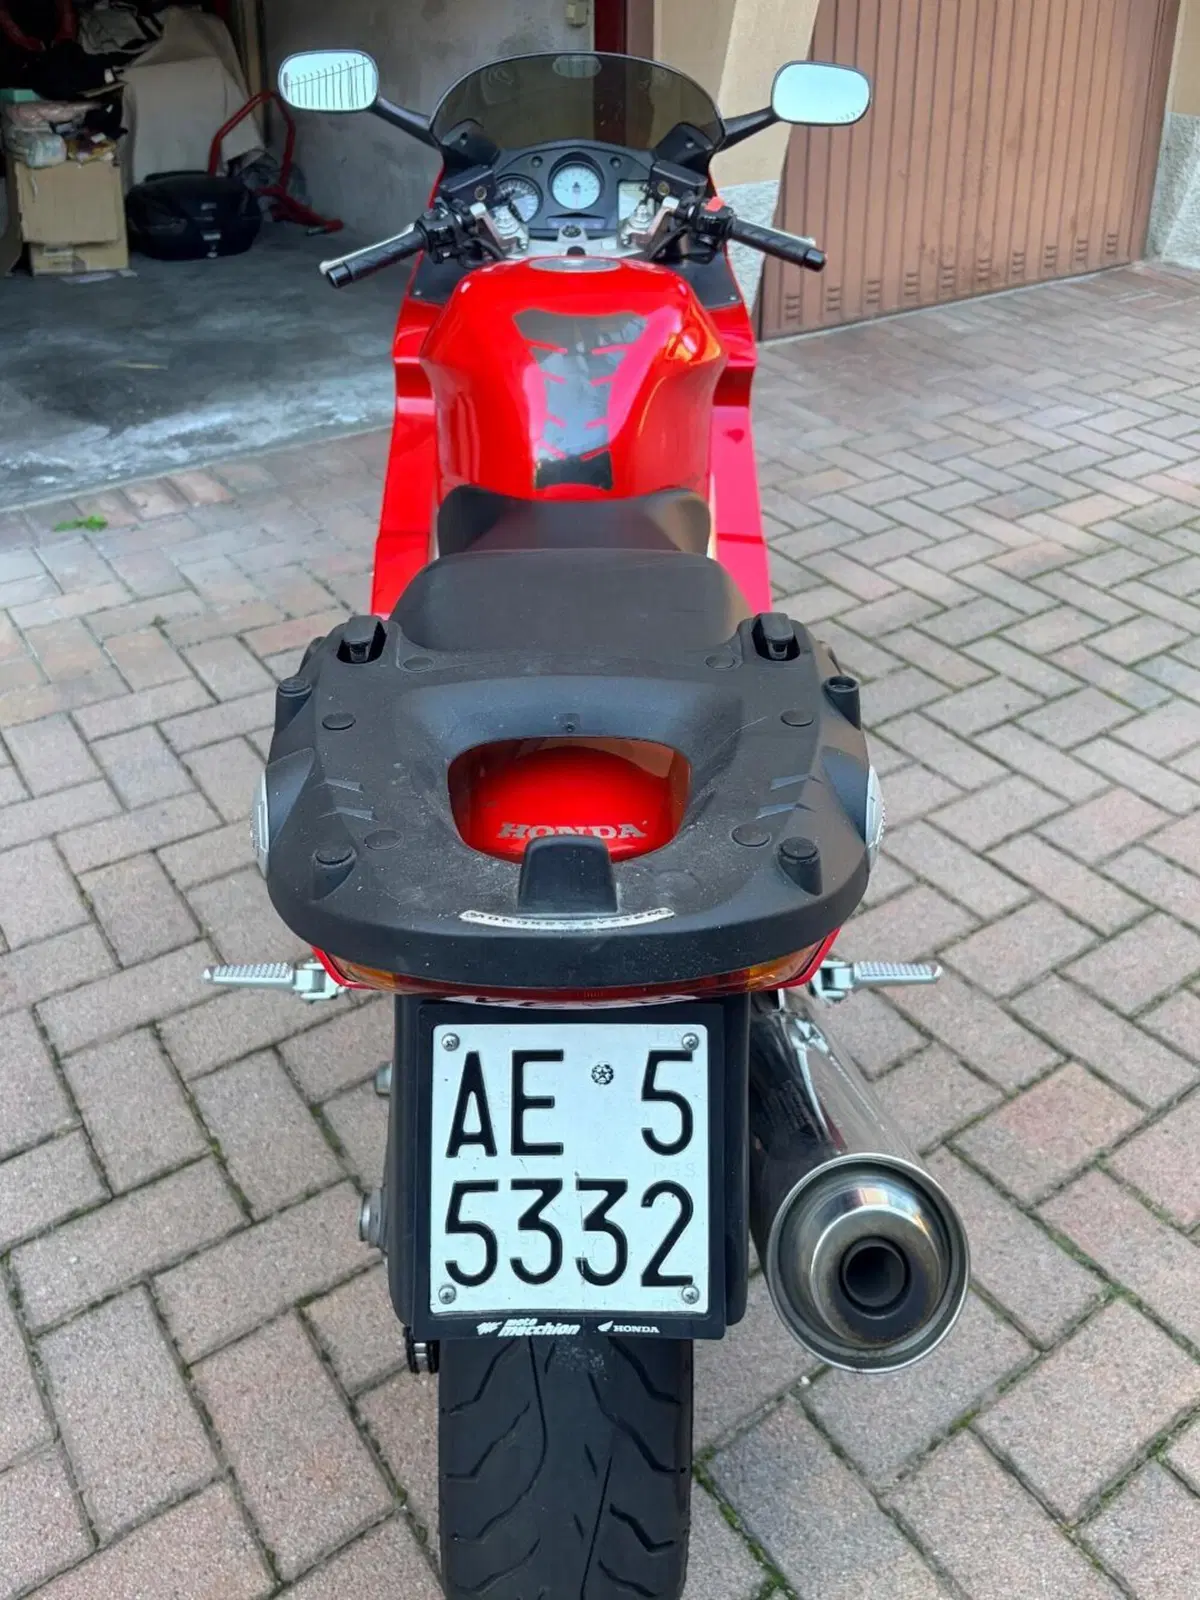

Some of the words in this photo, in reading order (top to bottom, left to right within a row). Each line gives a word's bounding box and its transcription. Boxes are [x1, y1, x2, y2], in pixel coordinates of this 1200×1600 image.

[497, 821, 648, 840] HONDA
[445, 1050, 564, 1158] AE
[641, 1050, 694, 1156] 5
[445, 1178, 694, 1287] 5332
[613, 1324, 660, 1333] HONDA
